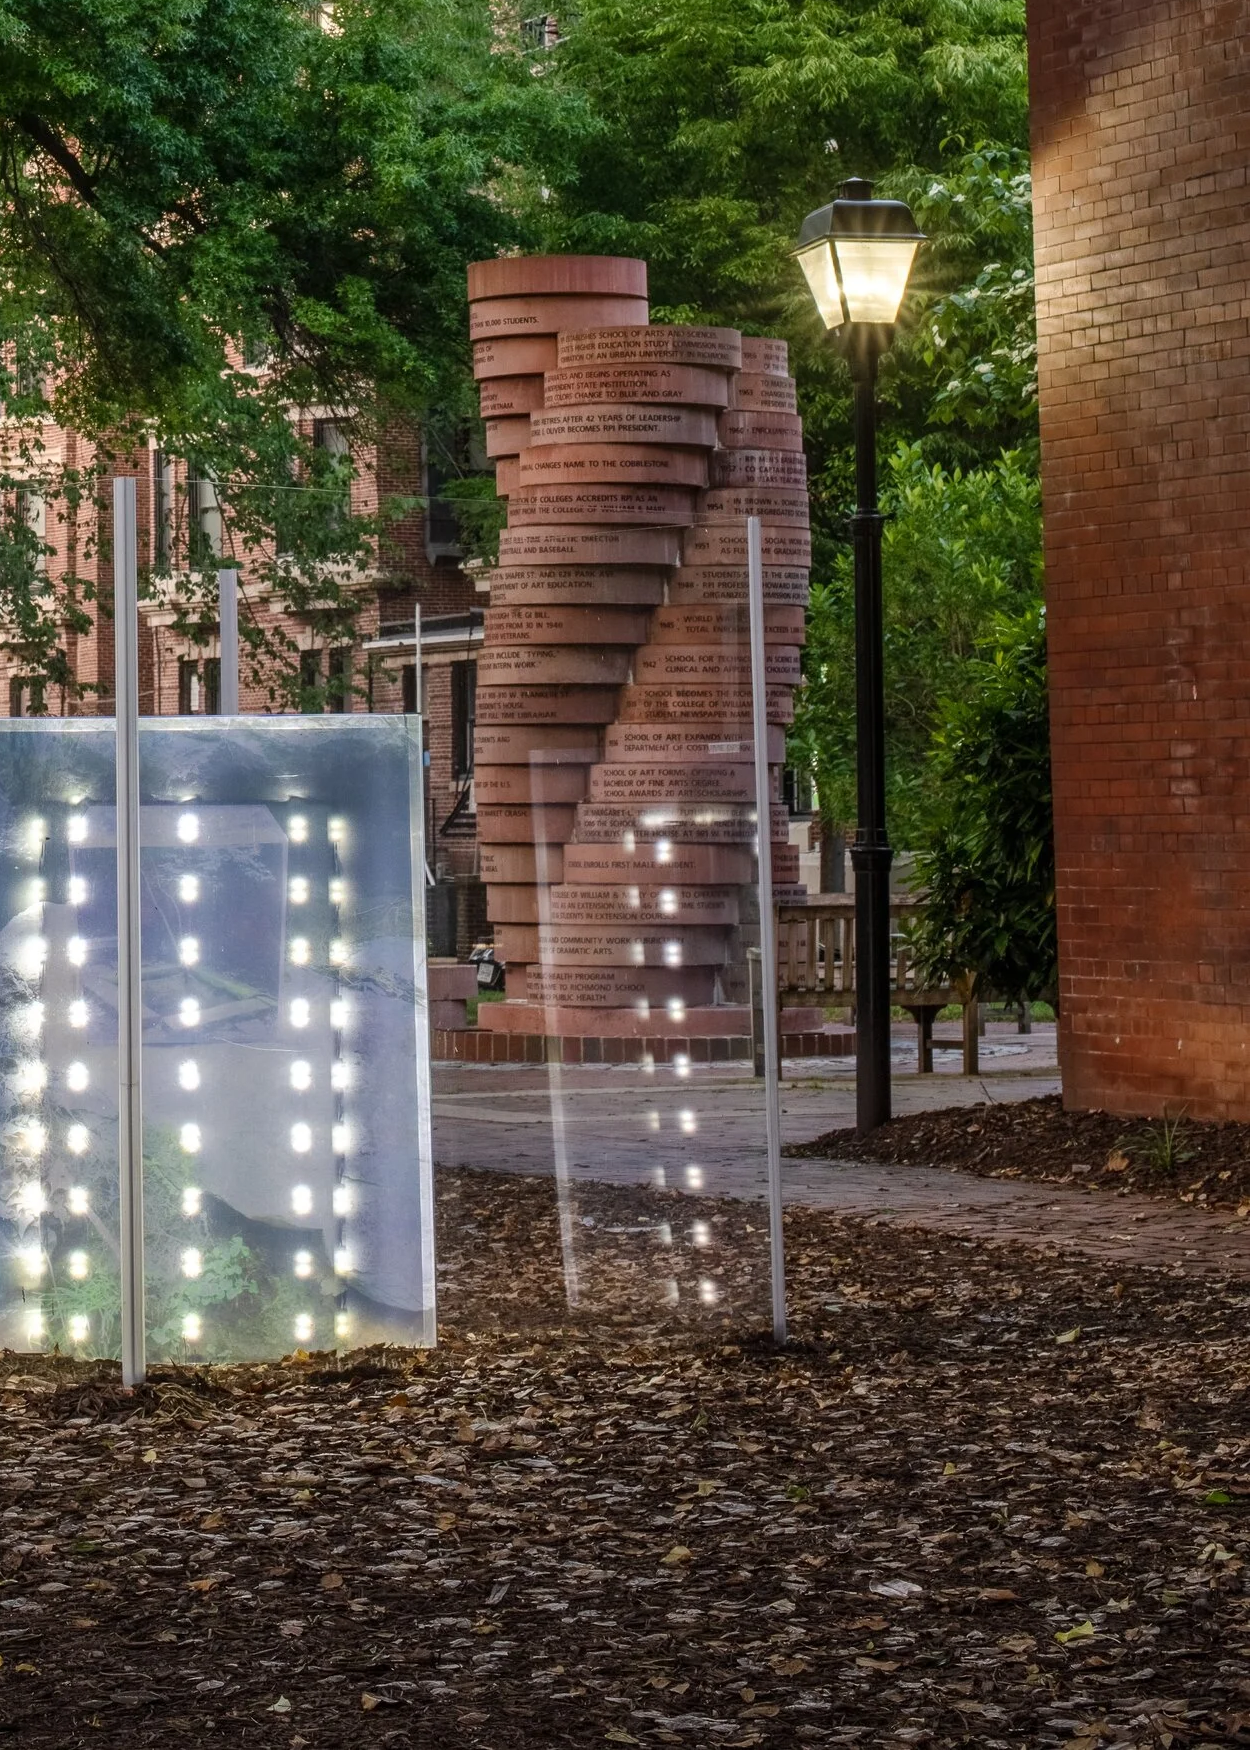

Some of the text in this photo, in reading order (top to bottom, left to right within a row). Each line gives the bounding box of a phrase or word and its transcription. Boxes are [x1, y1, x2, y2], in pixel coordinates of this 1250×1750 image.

[503, 316, 539, 324] STUDENTS.
[598, 329, 684, 339] SCHOOL OF ARTS AND
[598, 341, 640, 349] EDUCATION
[644, 340, 669, 348] STUDY
[609, 351, 636, 359] URBAN
[639, 350, 684, 358] UNIVERSITY
[570, 372, 583, 380] AND
[585, 370, 610, 378] BEGINS
[613, 369, 657, 378] OPERATING
[577, 381, 597, 389] STATE
[574, 391, 603, 400] CHANGE
[619, 390, 637, 398] BLUE
[640, 390, 659, 398] AND
[563, 416, 583, 424] AFTER
[567, 425, 600, 433] BECOMES
[618, 424, 660, 433] PRESIDENT.
[535, 462, 561, 470] CHANGES
[540, 496, 573, 504] COLLEGES
[505, 572, 524, 580] SHAFER
[521, 582, 528, 590] OF
[531, 581, 544, 589] ART
[506, 622, 523, 630] FROM
[496, 651, 520, 659] INCLUDE
[624, 744, 669, 752] DEPARTMENT
